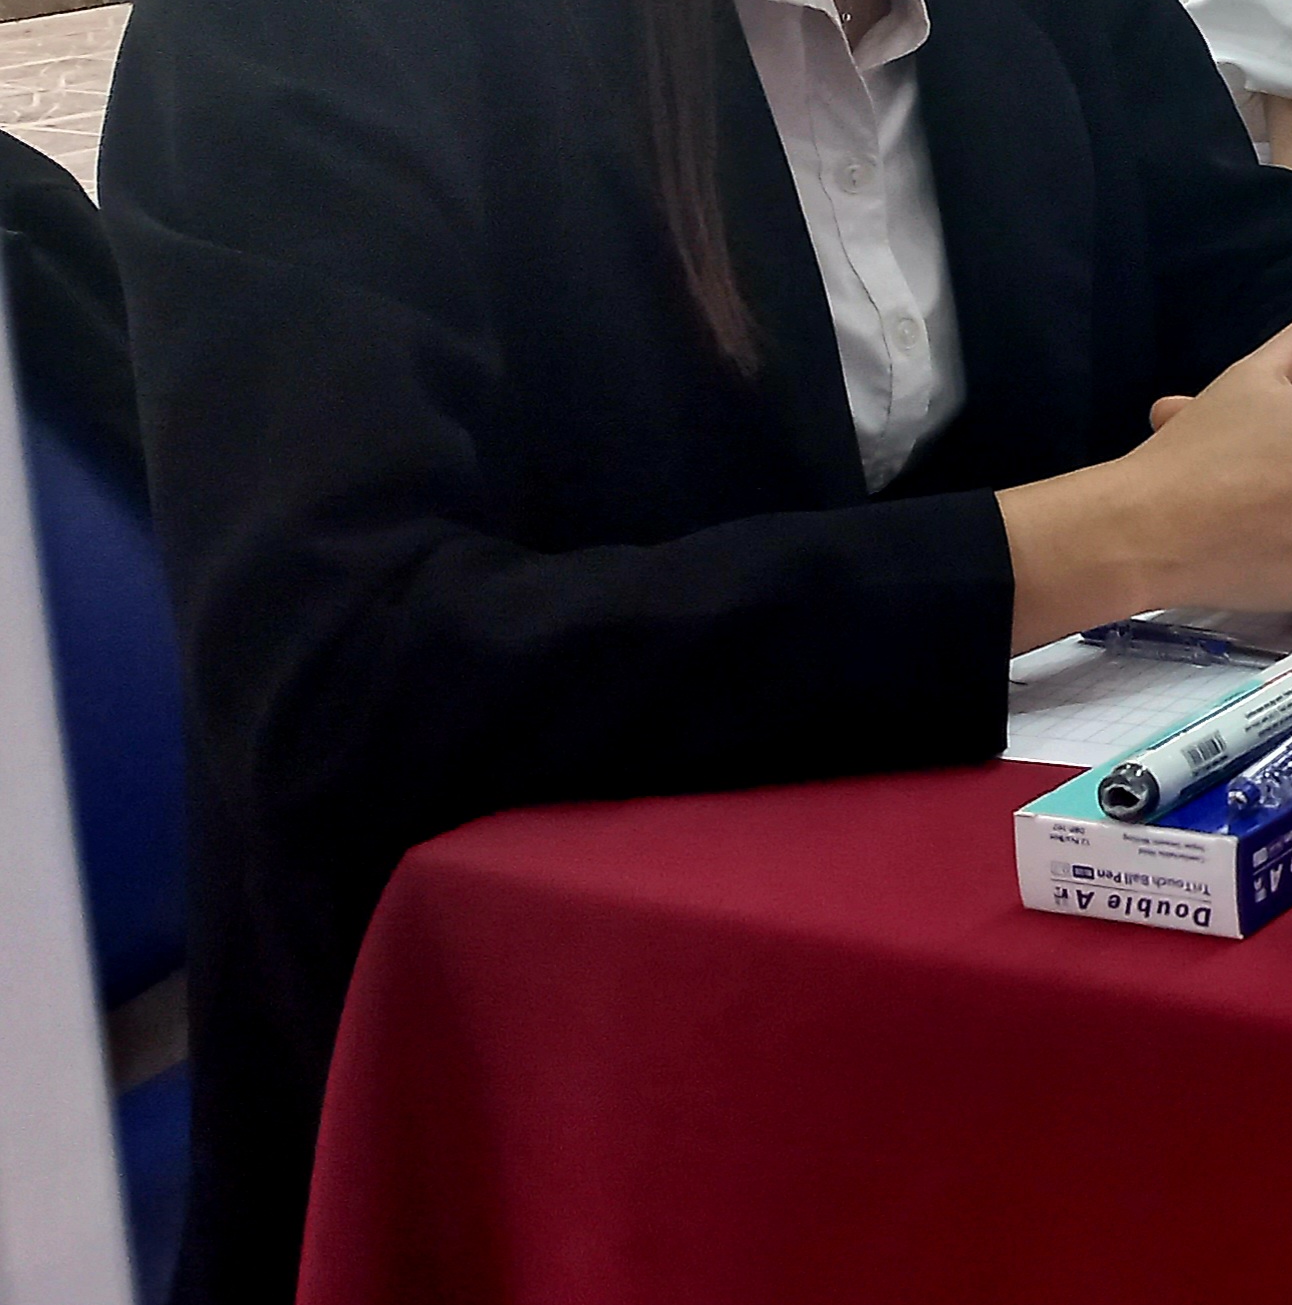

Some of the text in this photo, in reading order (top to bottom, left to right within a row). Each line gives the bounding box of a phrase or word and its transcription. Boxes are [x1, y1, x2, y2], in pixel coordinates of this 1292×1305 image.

[1097, 868, 1122, 883] Pen
[1125, 871, 1150, 886] Ball
[1075, 889, 1212, 928] Double A
